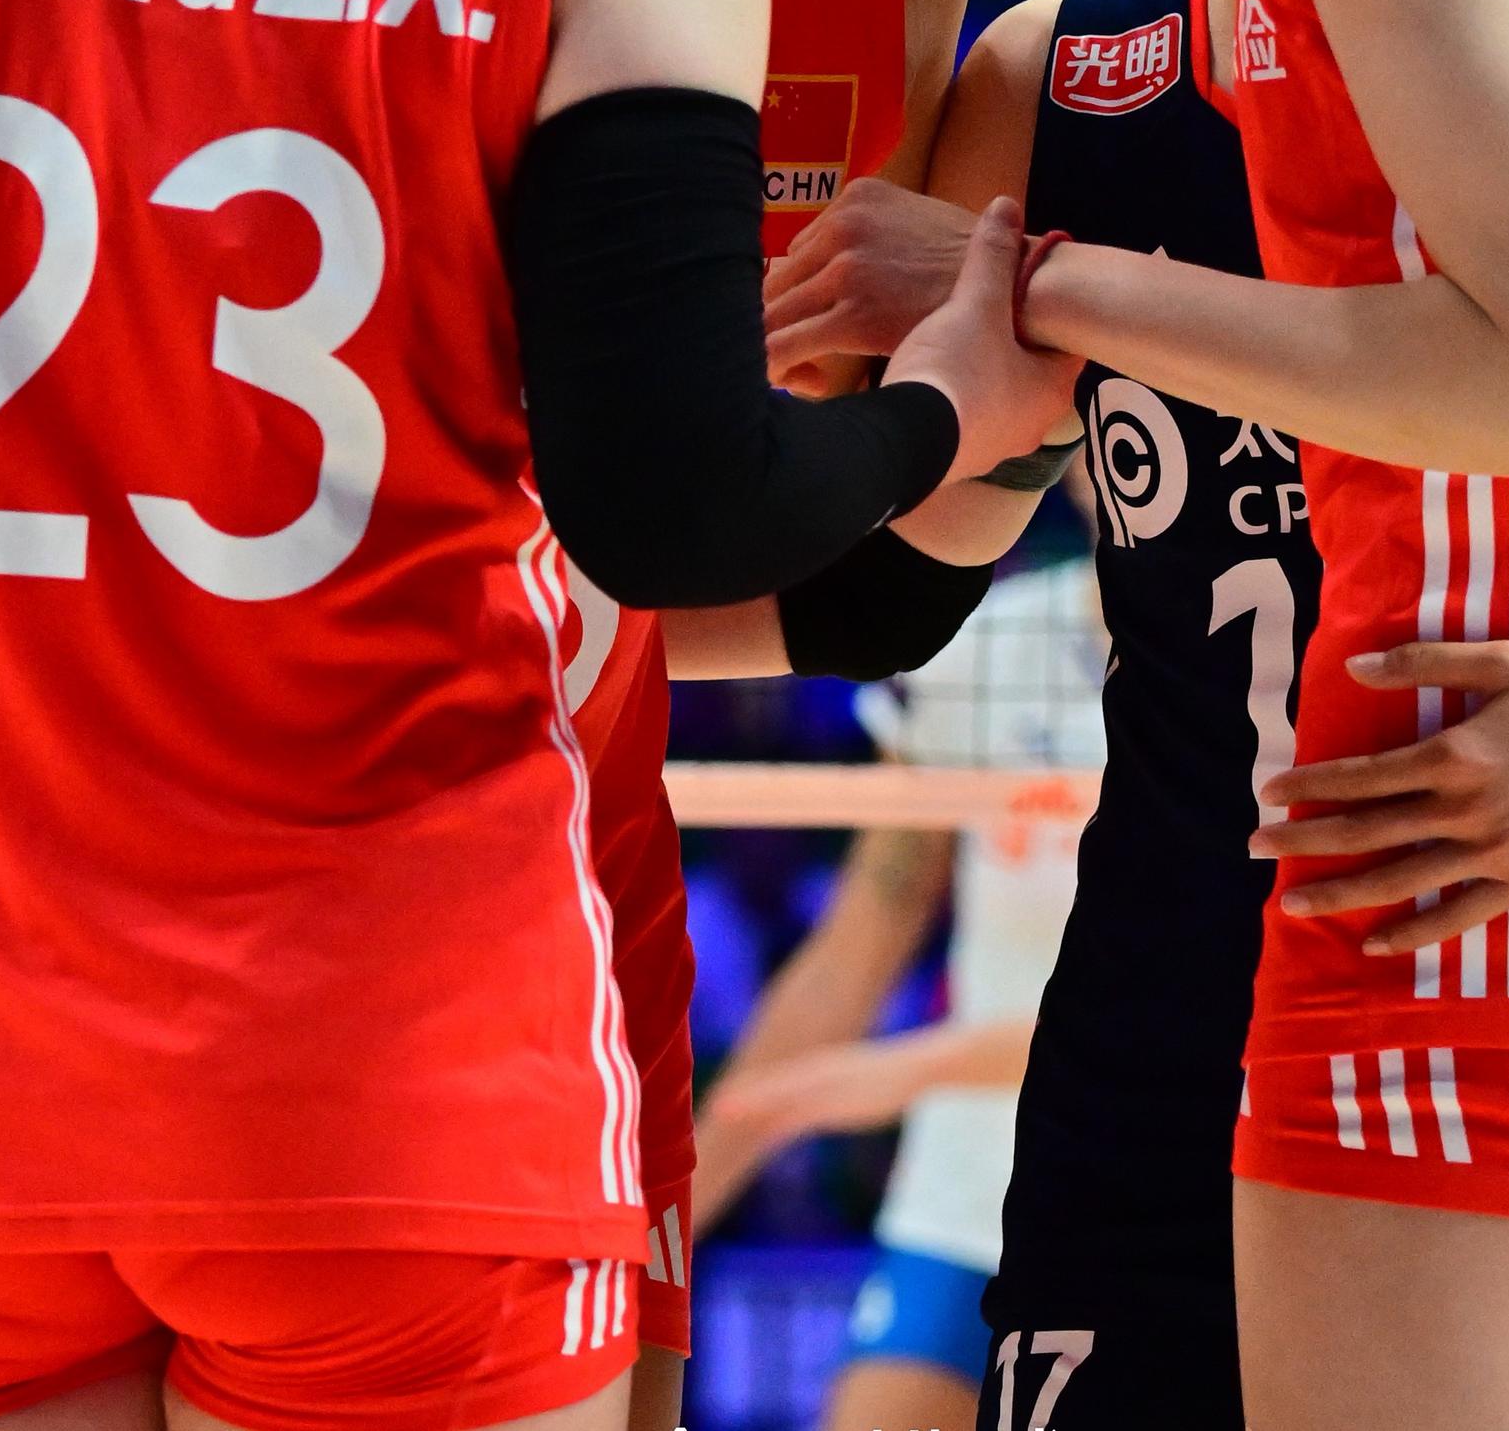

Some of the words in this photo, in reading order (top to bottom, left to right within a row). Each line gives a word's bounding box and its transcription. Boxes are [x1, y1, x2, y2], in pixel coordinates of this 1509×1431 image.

[1065, 24, 1171, 88] 光明
[763, 170, 837, 201] CHN
[995, 1329, 1096, 1431] 17
